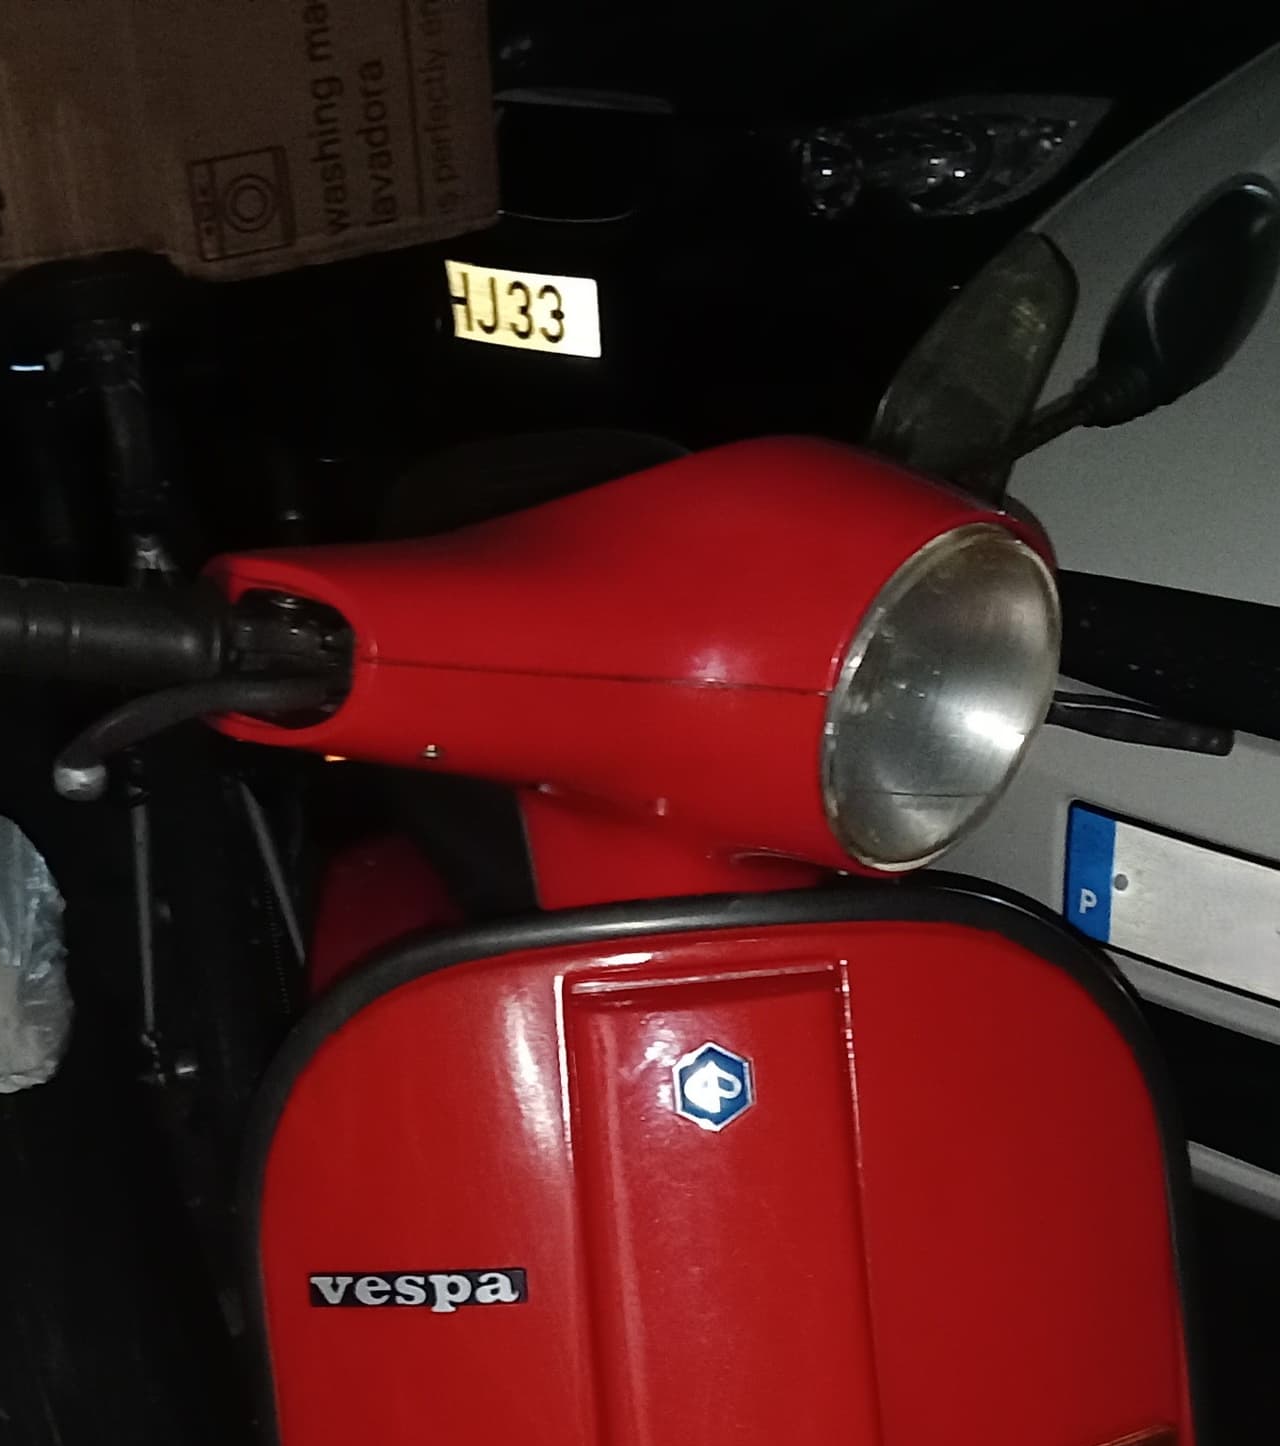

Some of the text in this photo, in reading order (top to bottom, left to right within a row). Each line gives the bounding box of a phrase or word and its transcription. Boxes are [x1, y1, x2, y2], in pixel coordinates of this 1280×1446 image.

[302, 0, 352, 236] washing ma
[356, 60, 398, 227] lavadora
[1079, 888, 1098, 914] P
[310, 1272, 520, 1313] vespa
